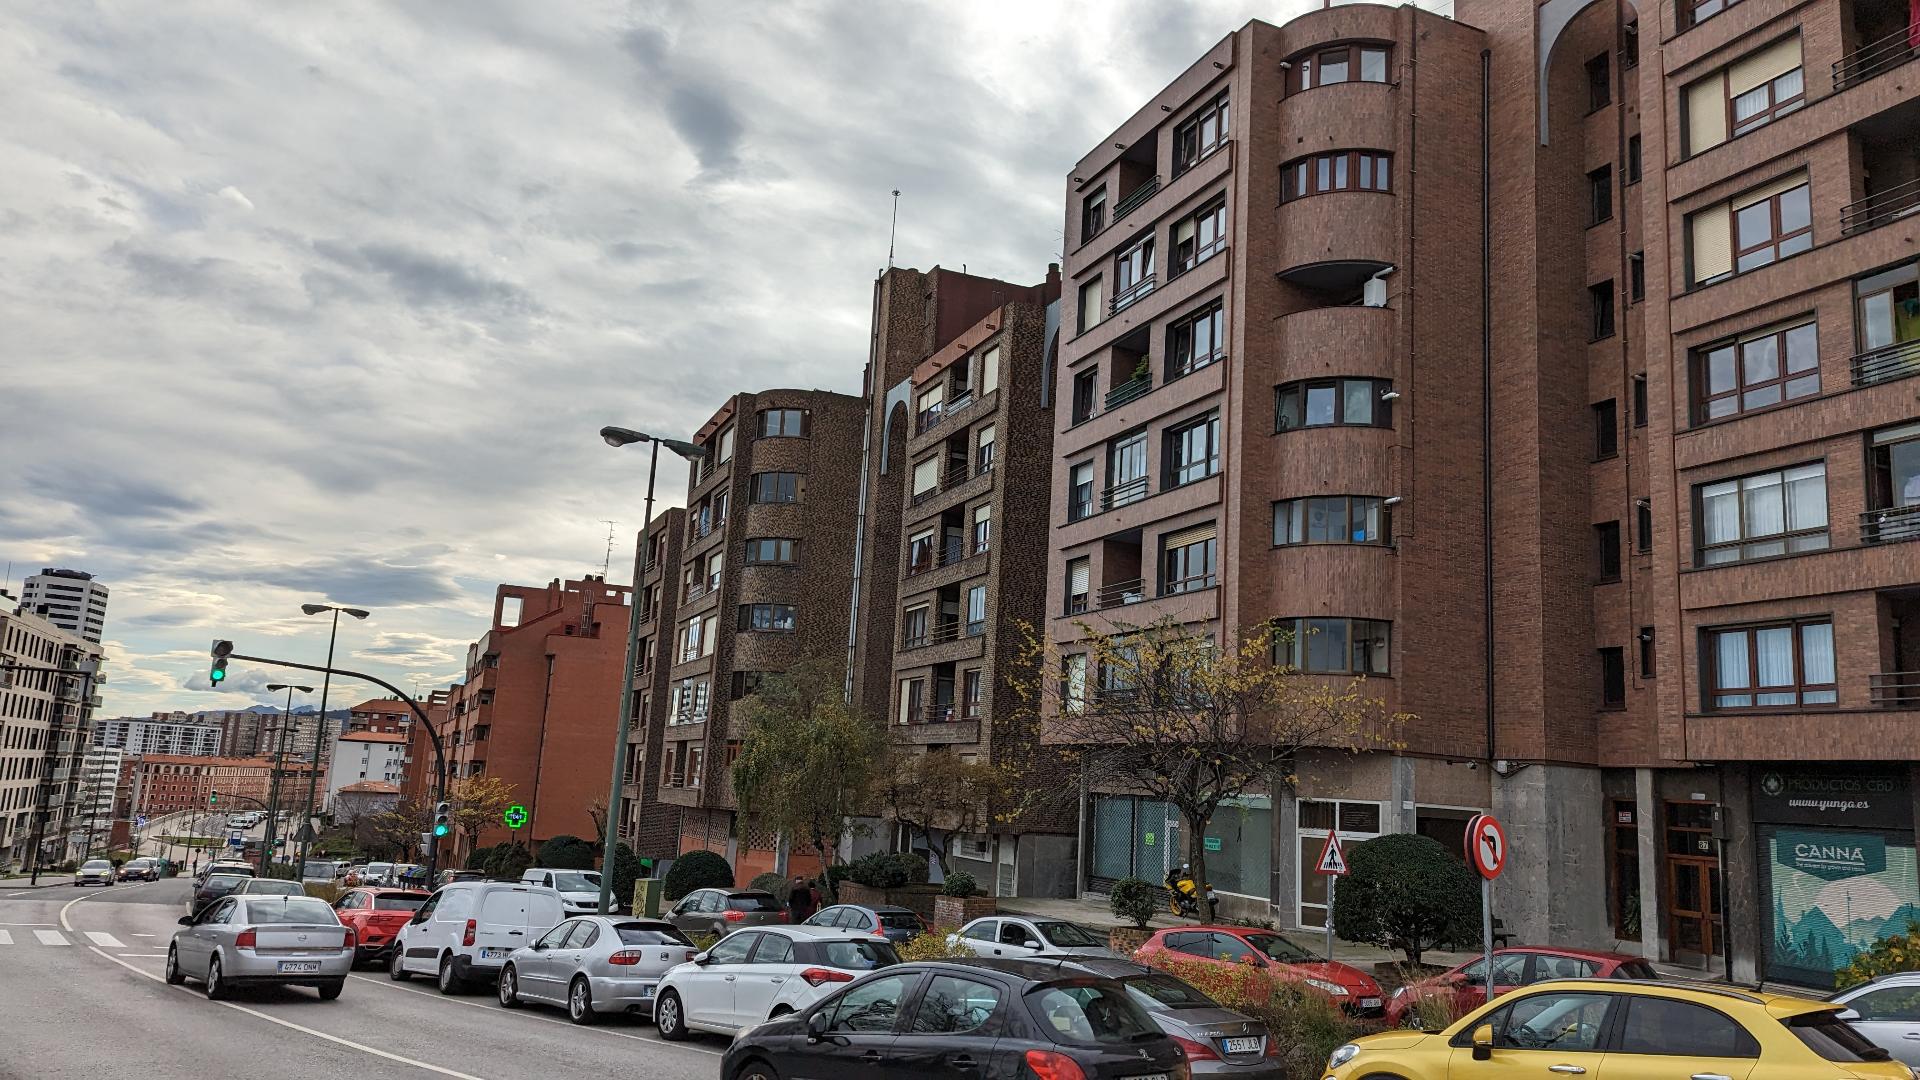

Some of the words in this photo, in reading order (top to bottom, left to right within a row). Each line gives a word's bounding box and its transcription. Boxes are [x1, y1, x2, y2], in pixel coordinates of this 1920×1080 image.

[1788, 777, 1862, 791] PRODUCTOS
[1867, 779, 1894, 792] CBD
[1788, 798, 1870, 811] www.yunga.es
[1795, 843, 1865, 861] CANNA
[1228, 1039, 1246, 1050] 2551
